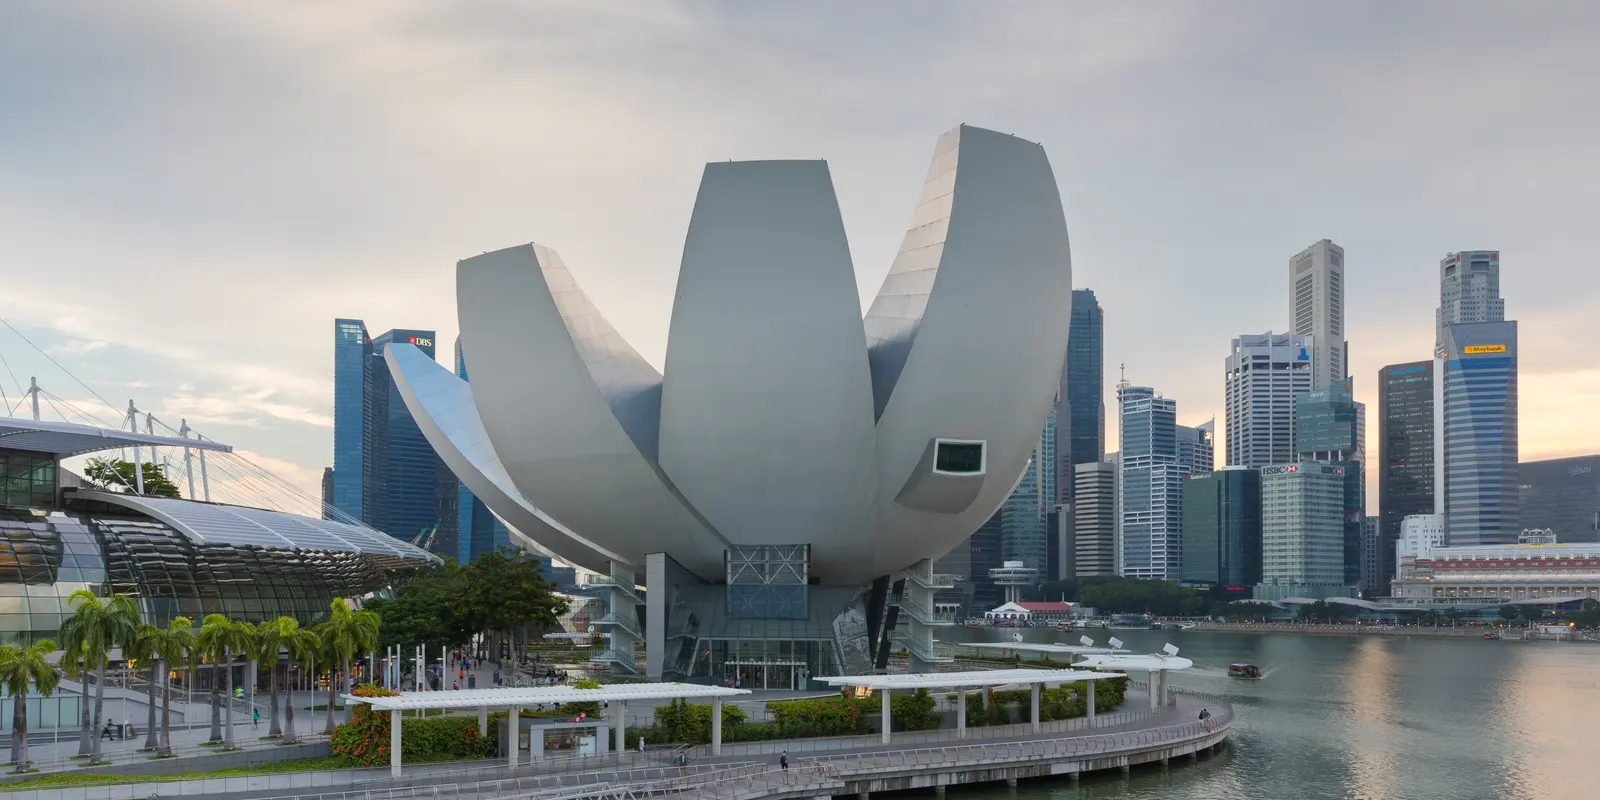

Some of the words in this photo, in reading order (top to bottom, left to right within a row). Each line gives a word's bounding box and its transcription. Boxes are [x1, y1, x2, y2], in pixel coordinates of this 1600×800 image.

[416, 337, 432, 347] DBS
[1473, 345, 1503, 353] Maybank
[1262, 466, 1286, 475] HSBC
